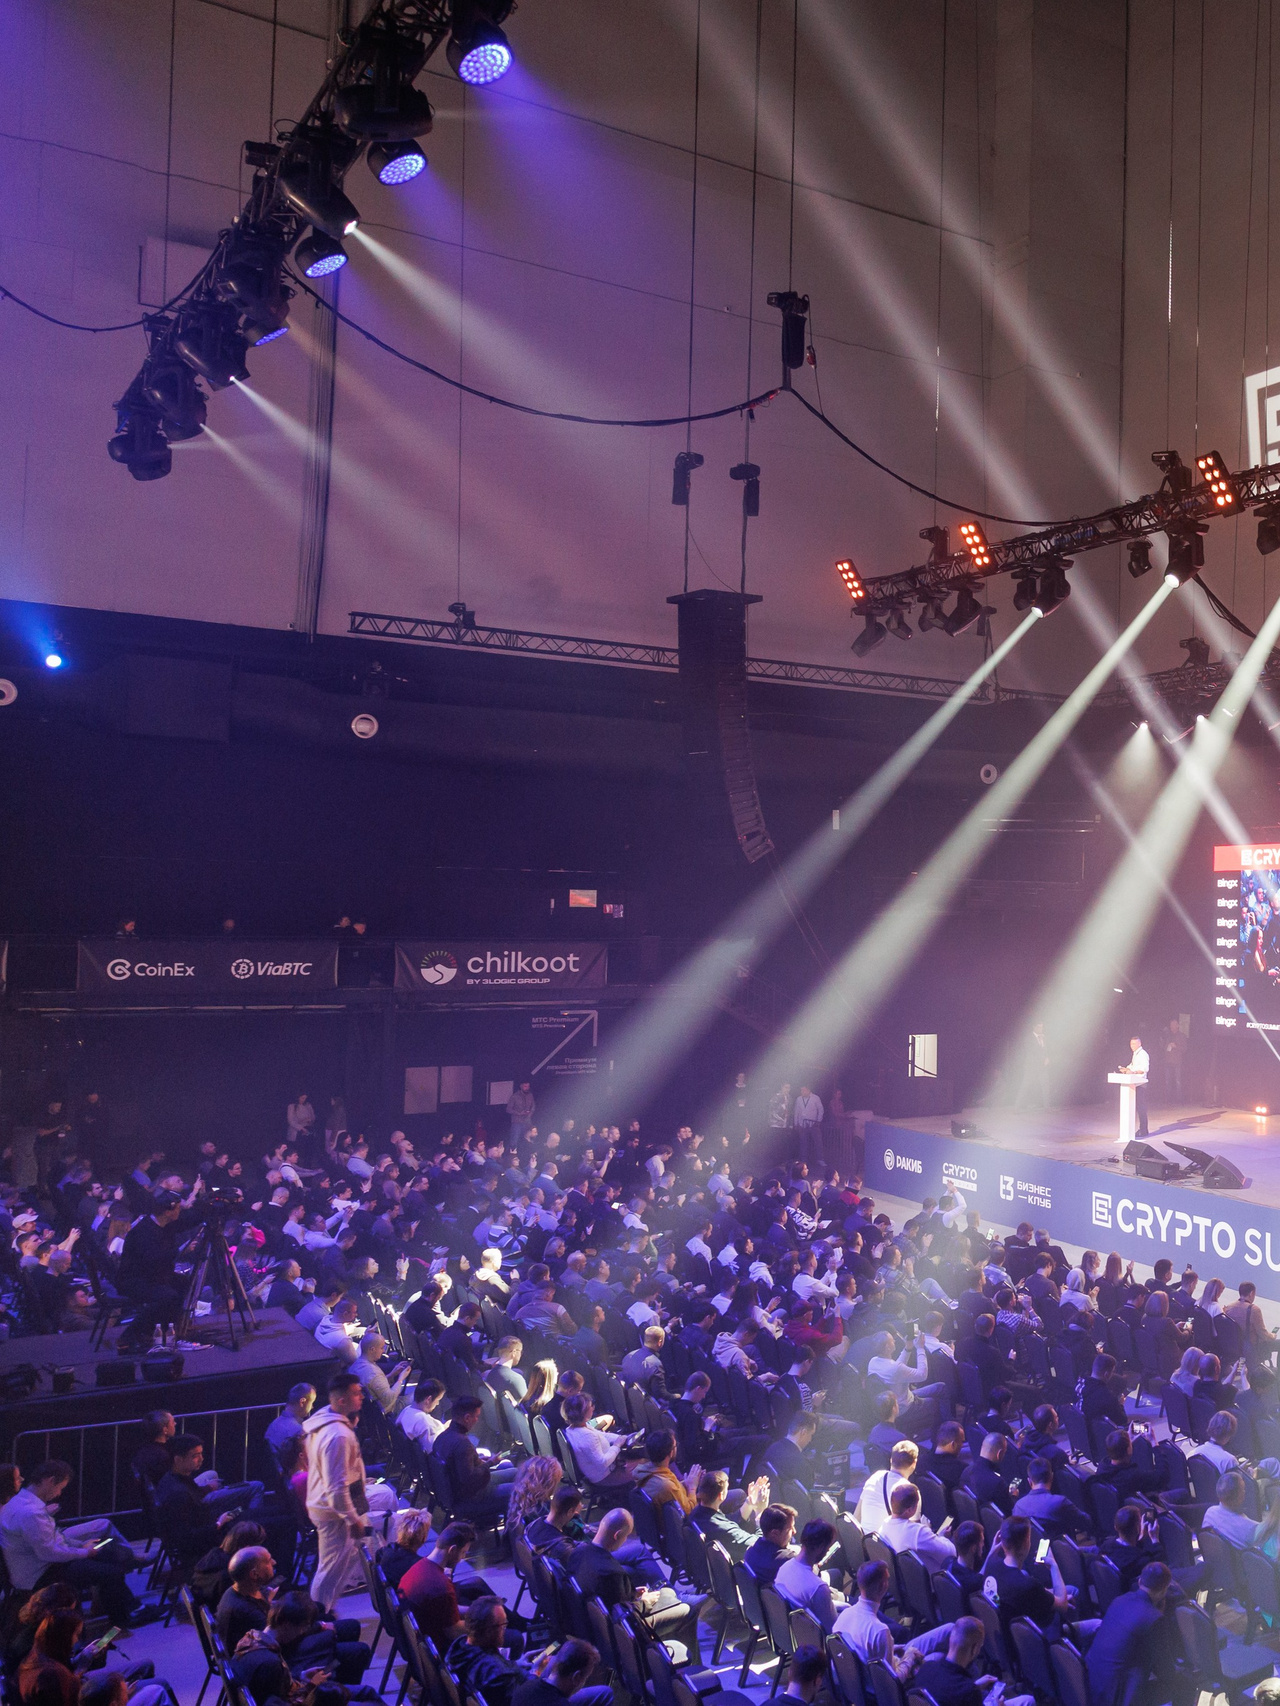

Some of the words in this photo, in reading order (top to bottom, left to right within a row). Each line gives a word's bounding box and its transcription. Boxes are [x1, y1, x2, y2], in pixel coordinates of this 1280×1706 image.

[134, 963, 195, 977] CoinEx
[257, 962, 312, 976] ViaBTC
[467, 951, 580, 973] chilkoot
[896, 1155, 922, 1174] РАКИБ
[943, 1162, 977, 1181] CRYPTO
[1017, 1181, 1051, 1197] БИЗНЕС
[1117, 1199, 1236, 1259] CRYPTO
